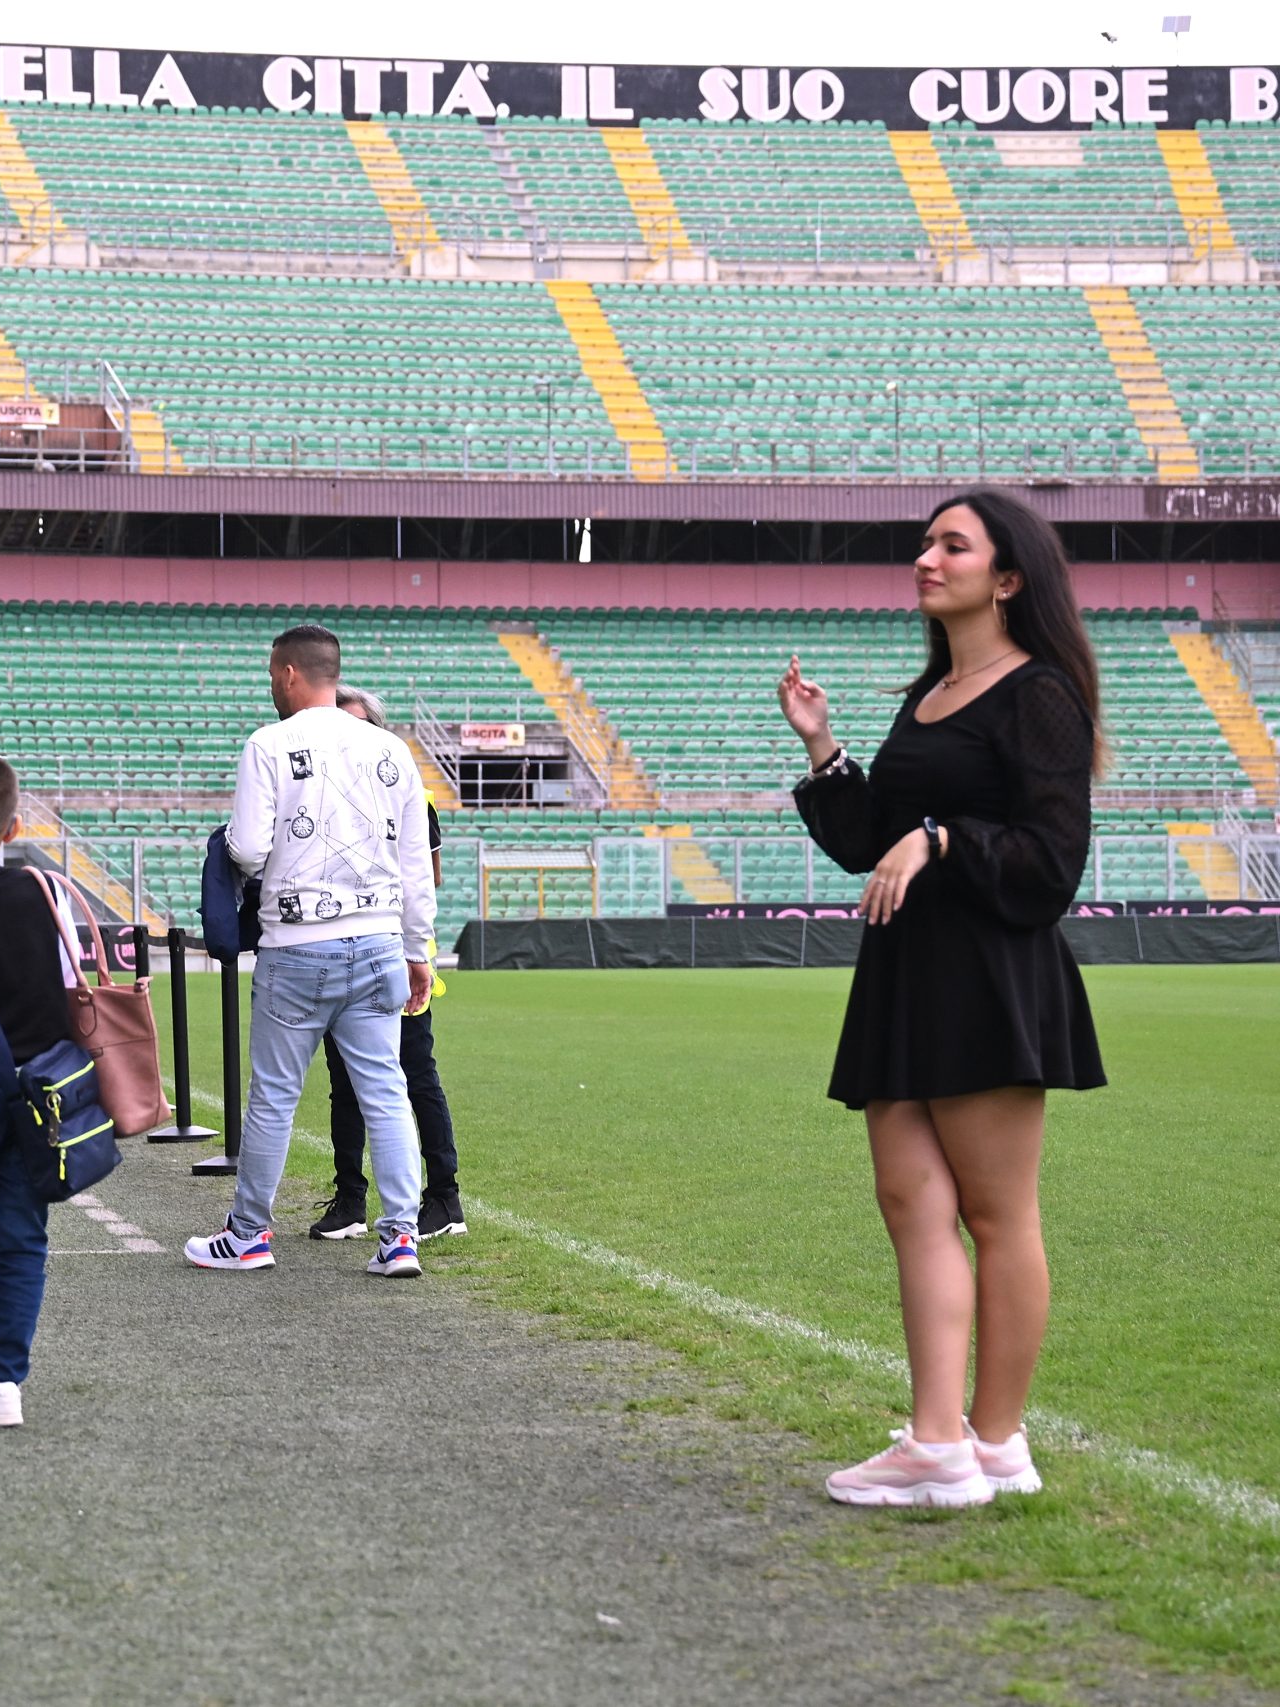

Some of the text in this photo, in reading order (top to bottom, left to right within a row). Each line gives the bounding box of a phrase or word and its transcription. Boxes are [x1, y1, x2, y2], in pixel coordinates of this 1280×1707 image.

[561, 65, 633, 120] IL
[698, 66, 845, 122] SUO
[909, 68, 1168, 123] CUORE
[0, 406, 41, 416] USCITA
[463, 729, 507, 739] USCITA
